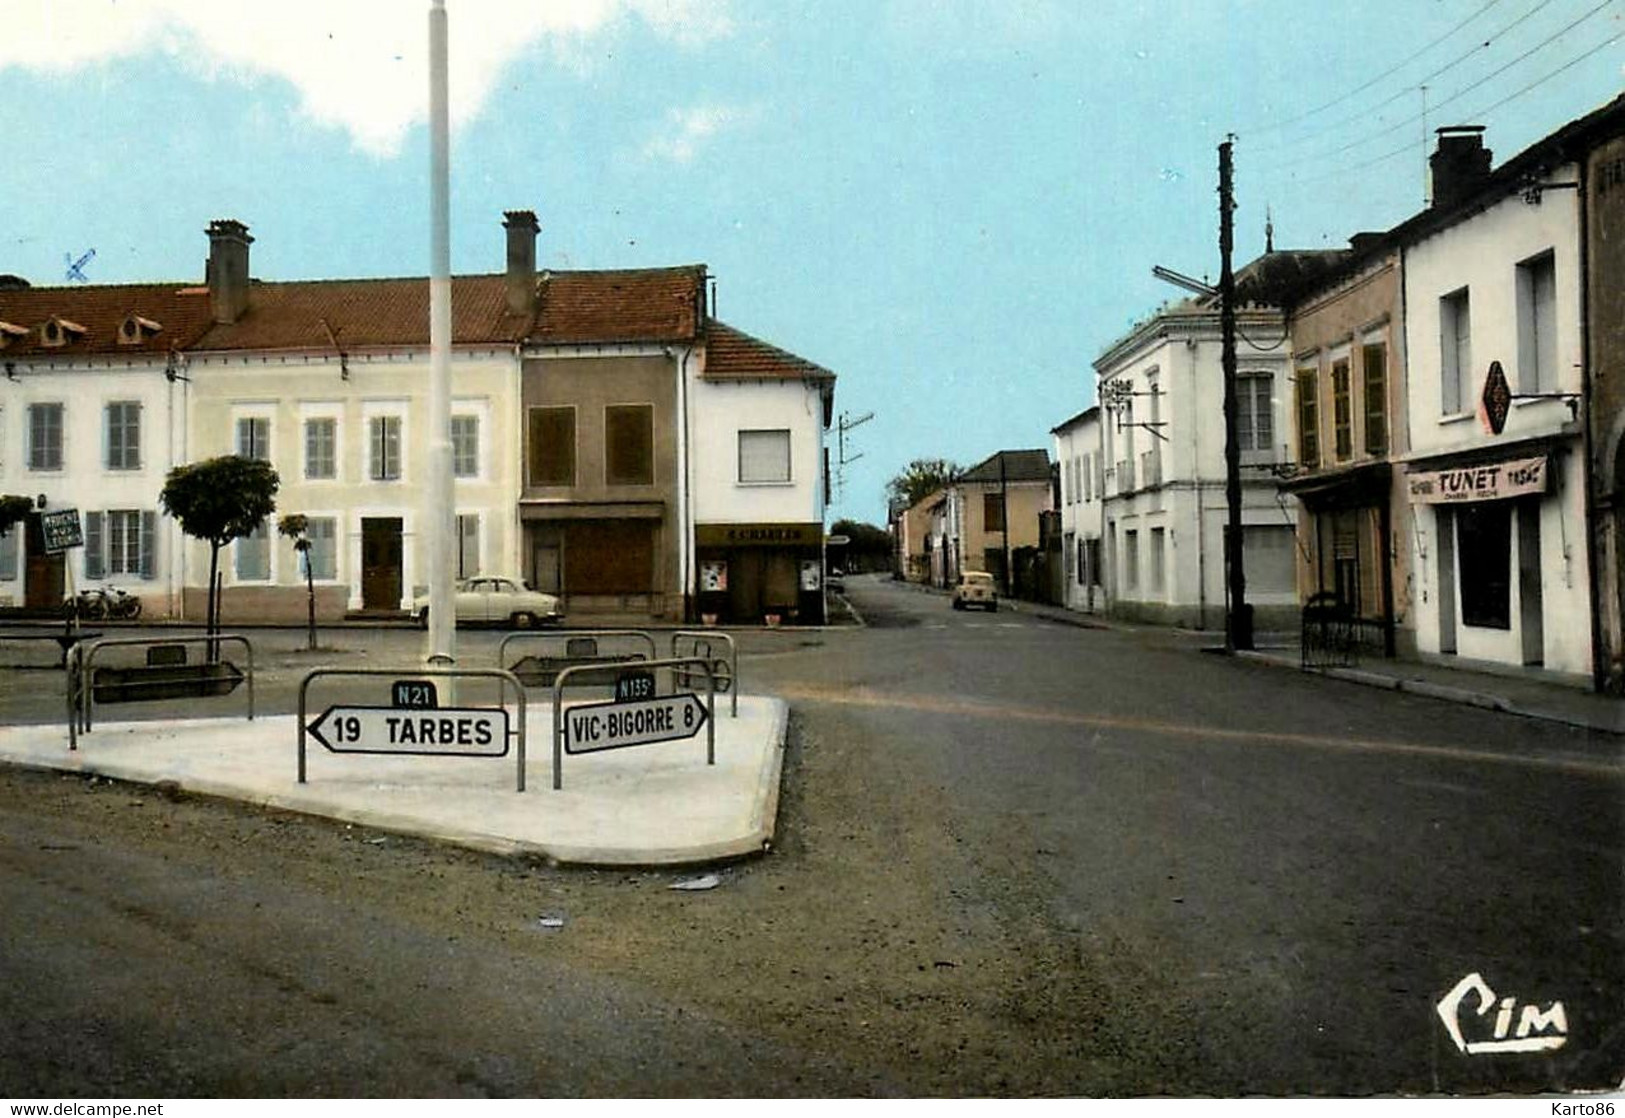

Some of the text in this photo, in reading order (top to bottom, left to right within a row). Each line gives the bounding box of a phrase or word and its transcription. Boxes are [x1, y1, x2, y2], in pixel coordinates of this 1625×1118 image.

[1440, 468, 1501, 491] TUNET
[400, 686, 430, 704] N21
[683, 704, 694, 728] 8
[333, 717, 492, 745] 19 TARBES
